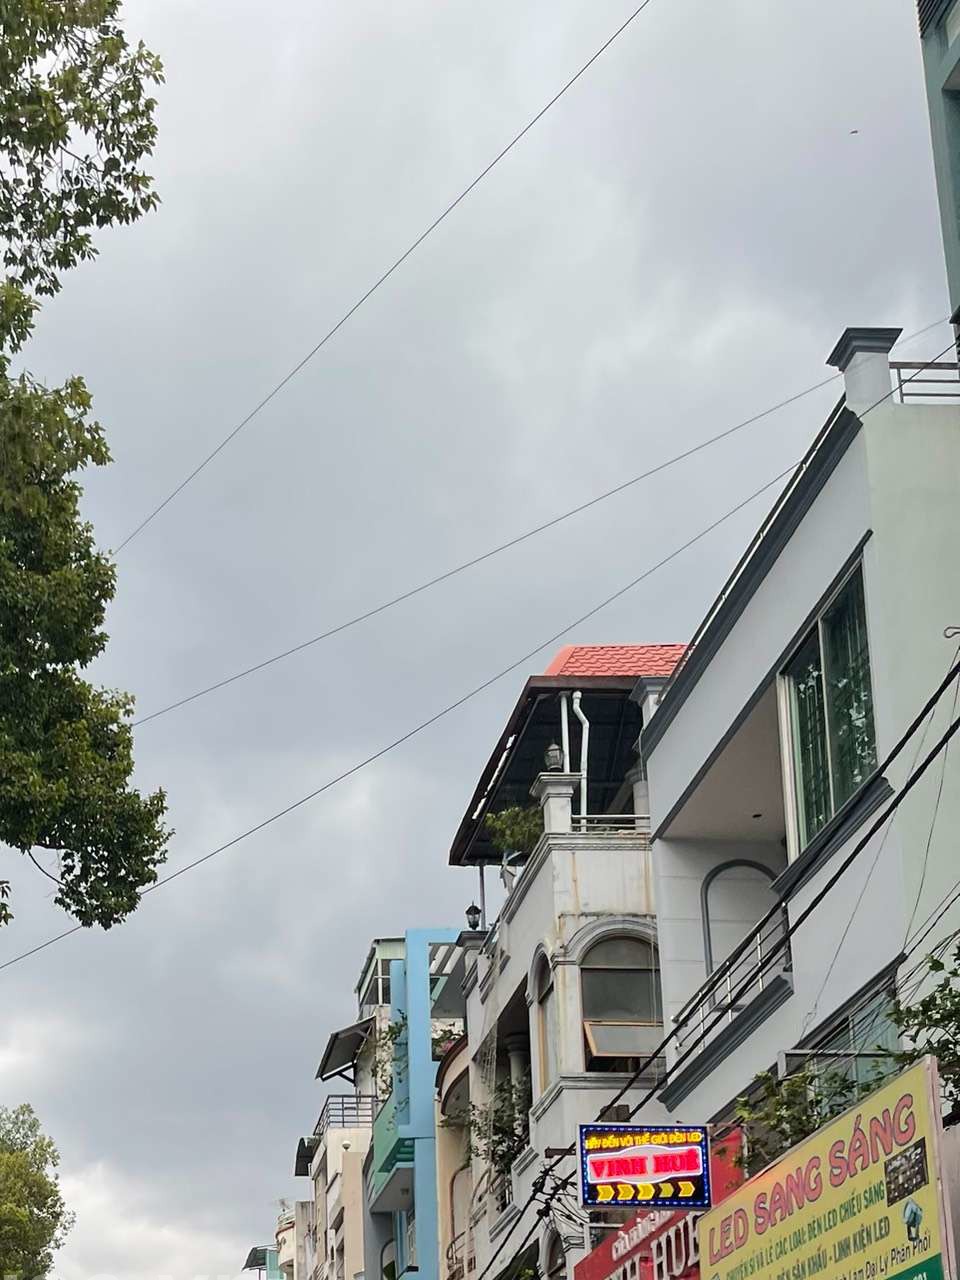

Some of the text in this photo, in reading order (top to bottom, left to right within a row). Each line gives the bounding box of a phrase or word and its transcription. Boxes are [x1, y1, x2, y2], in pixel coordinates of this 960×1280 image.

[686, 1132, 703, 1142] LED
[591, 1156, 647, 1178] VINH
[709, 1208, 749, 1266] LED
[754, 1155, 823, 1235] SANG
[829, 1093, 916, 1187] SÁNG
[823, 1206, 838, 1231] LED
[862, 1173, 885, 1209] SÁNG
[833, 1235, 851, 1263] LINH
[872, 1214, 890, 1243] LED
